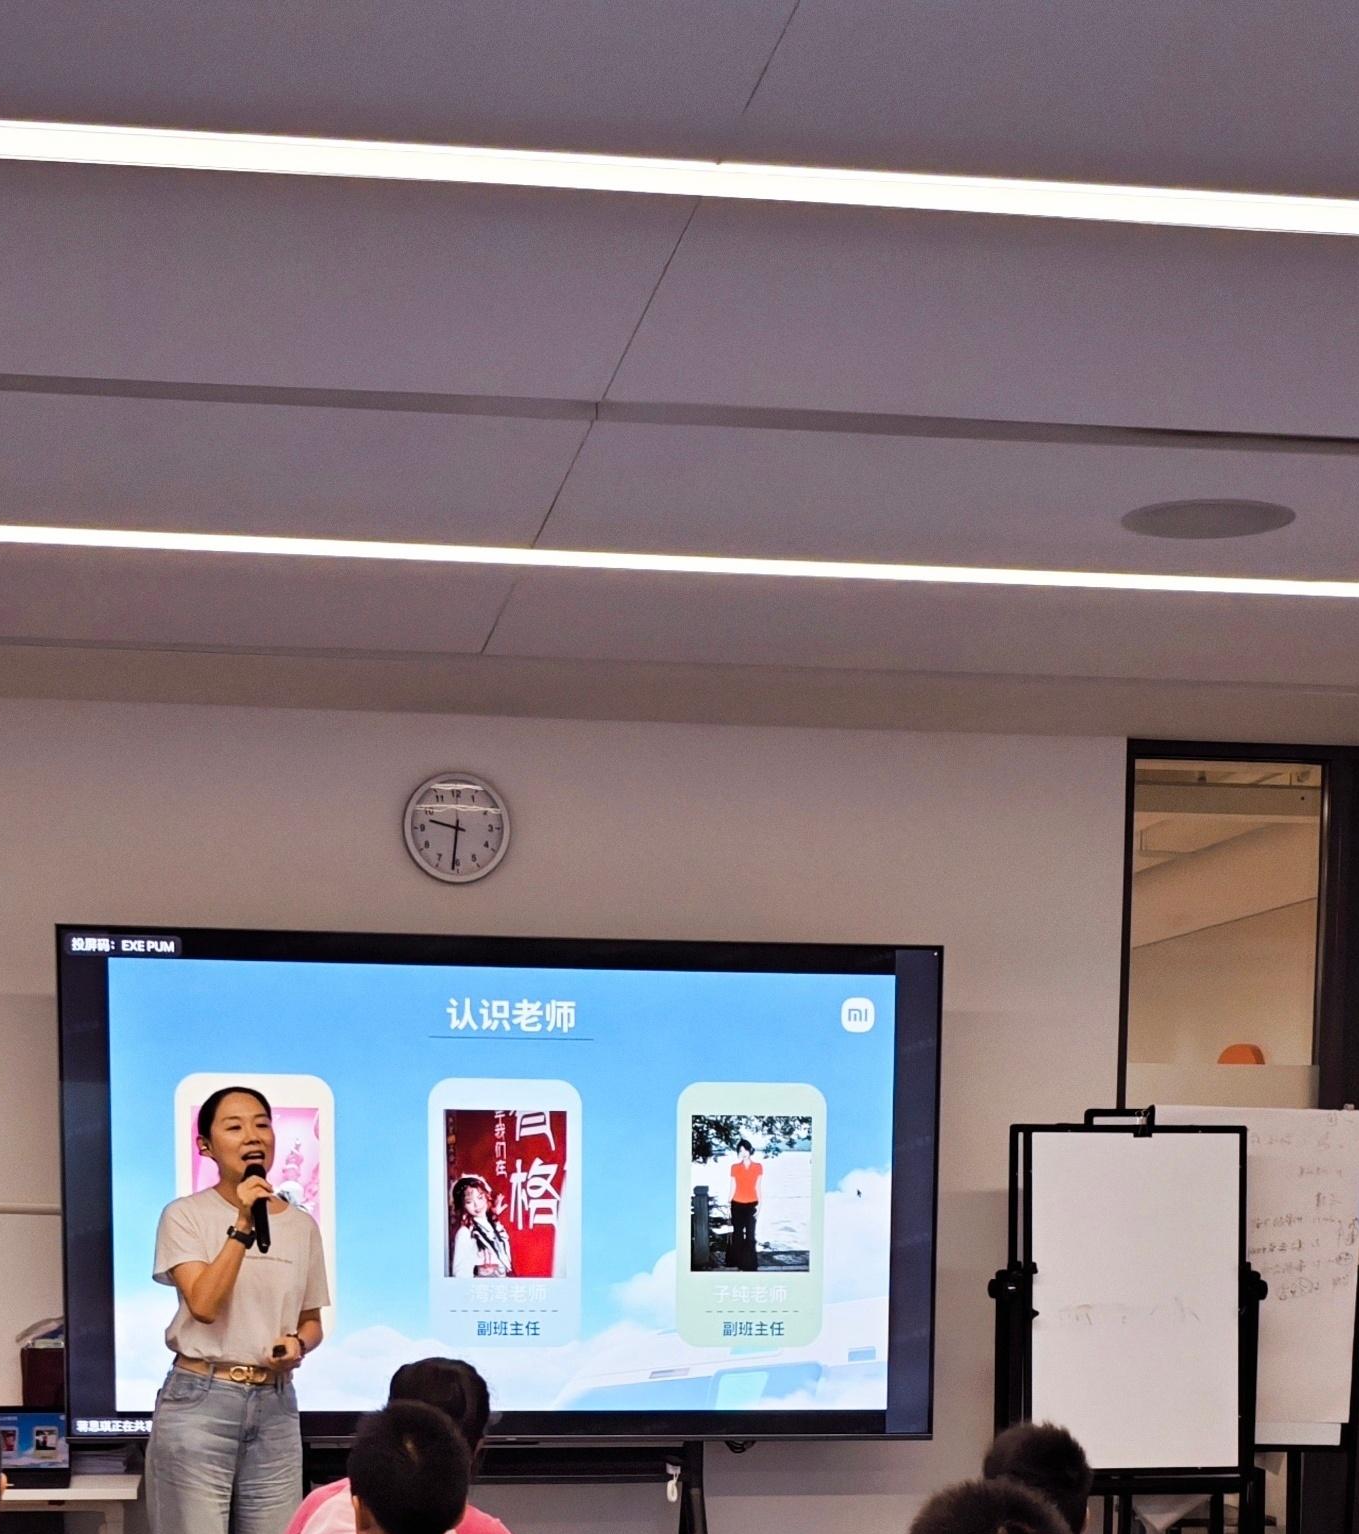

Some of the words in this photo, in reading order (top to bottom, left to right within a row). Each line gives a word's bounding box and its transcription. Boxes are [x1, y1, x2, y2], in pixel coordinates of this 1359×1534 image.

[435, 794, 444, 803] 11
[451, 789, 461, 798] 12
[121, 939, 145, 952] EXE
[146, 940, 175, 953] PUM
[446, 997, 577, 1033] 认识老师
[477, 1320, 540, 1336] 副班主任
[723, 1320, 785, 1336] 副班主任
